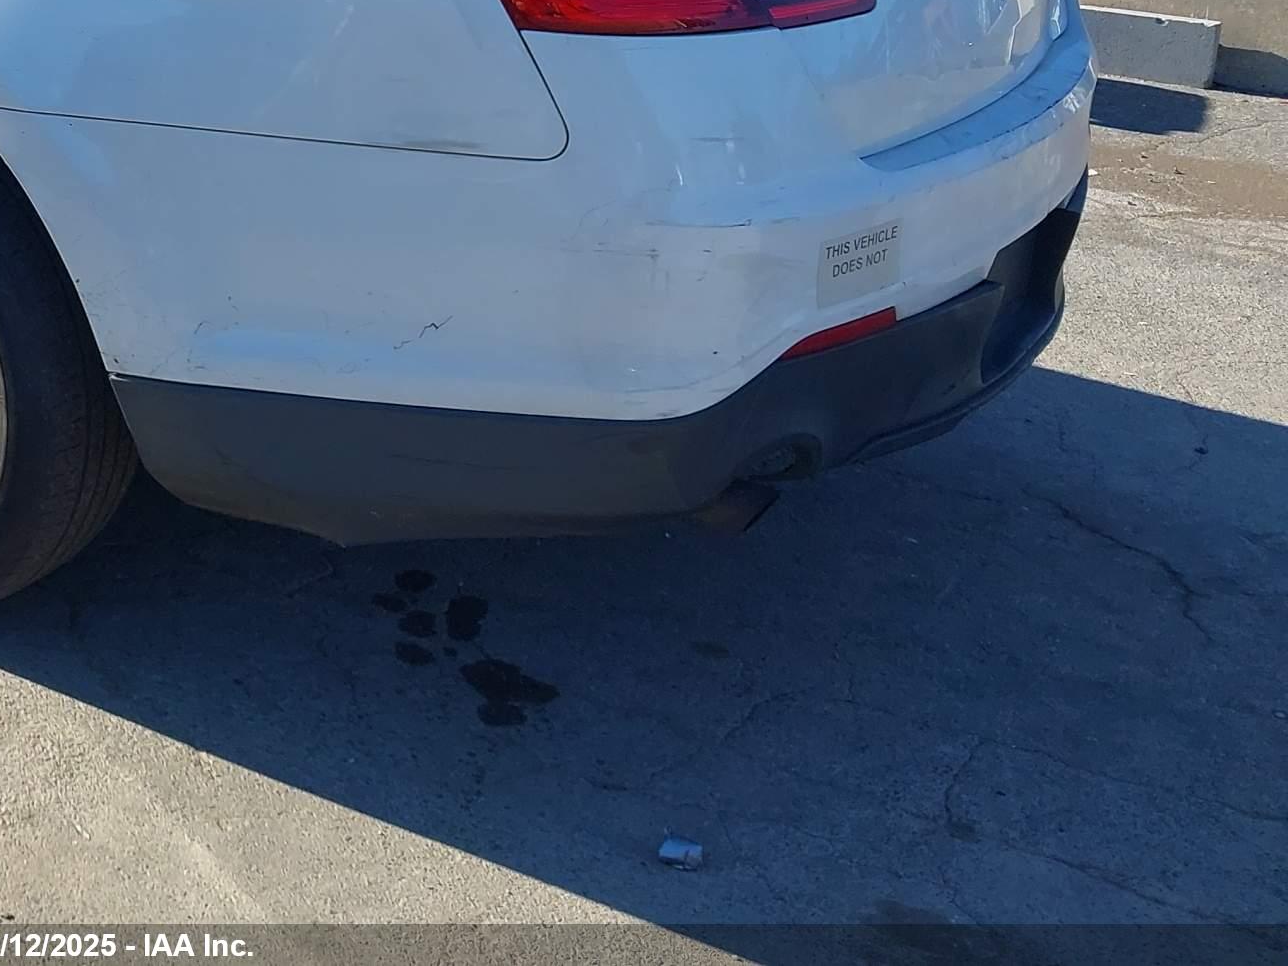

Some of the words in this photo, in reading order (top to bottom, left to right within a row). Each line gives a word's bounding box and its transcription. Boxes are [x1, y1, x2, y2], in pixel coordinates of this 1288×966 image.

[826, 241, 850, 260] THIS
[854, 225, 898, 251] VEHICLE
[832, 257, 863, 278] DOES
[865, 248, 888, 267] NOT
